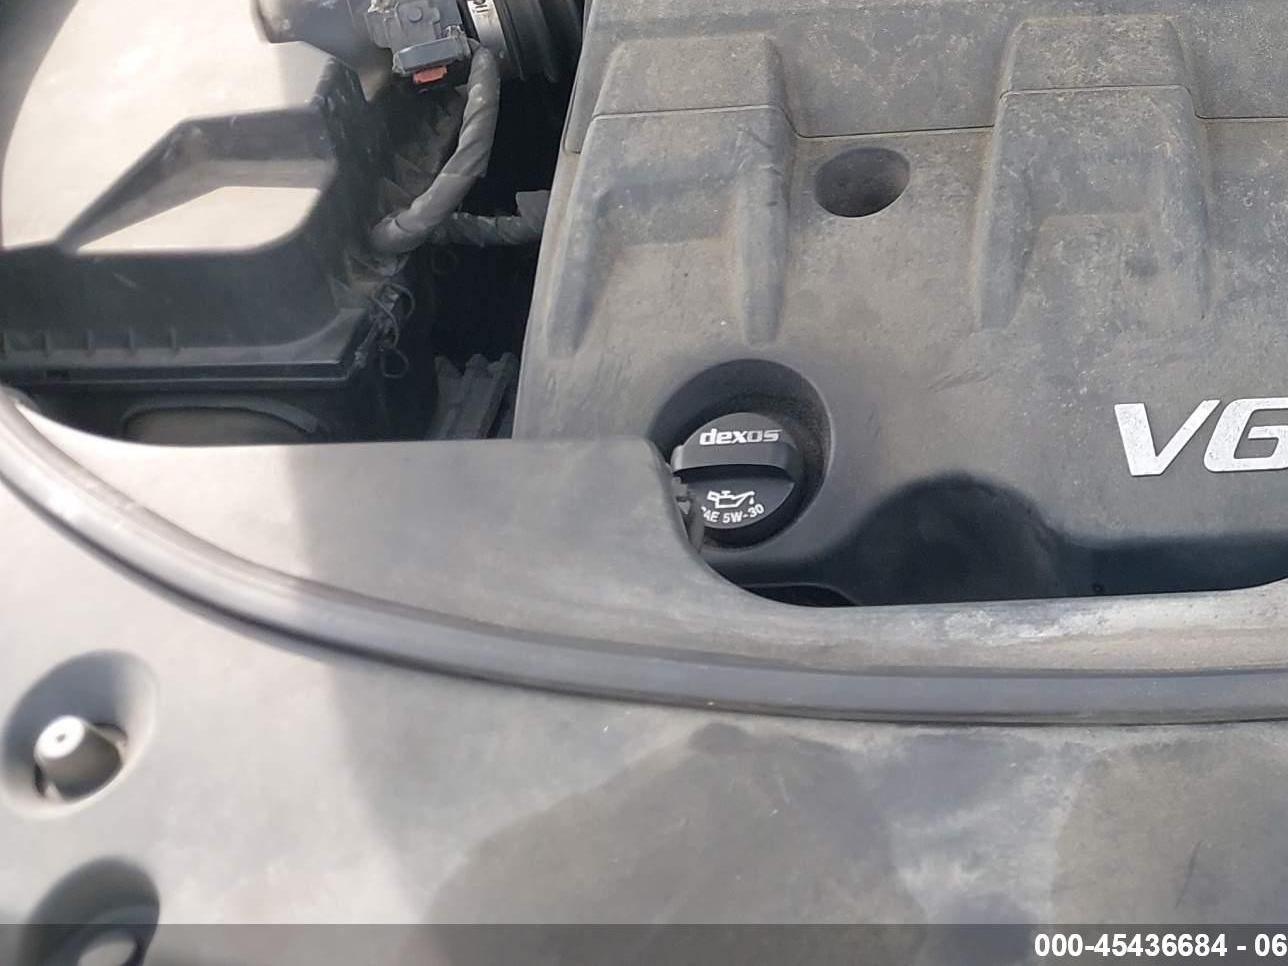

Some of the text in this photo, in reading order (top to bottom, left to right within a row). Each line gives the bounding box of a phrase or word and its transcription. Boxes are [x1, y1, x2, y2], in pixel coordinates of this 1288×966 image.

[699, 428, 782, 446] dexos
[700, 503, 765, 524] AE 5W-30
